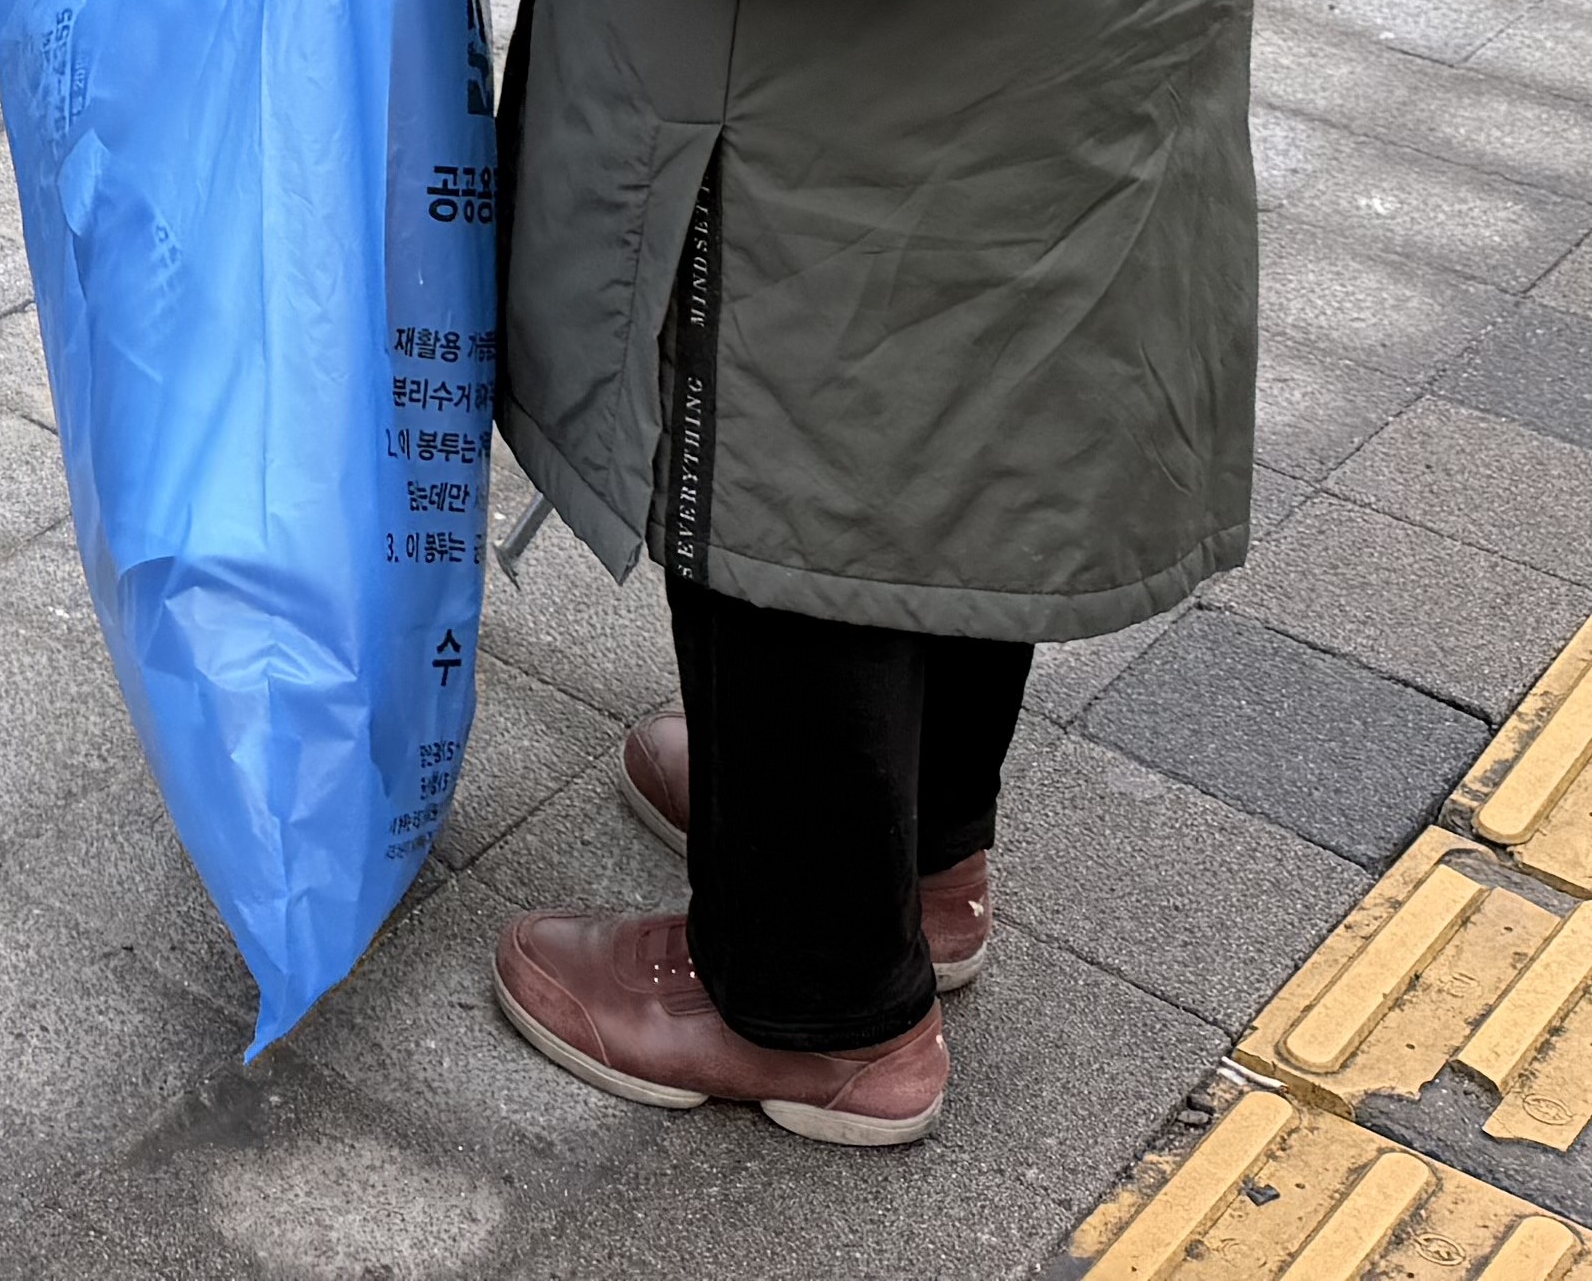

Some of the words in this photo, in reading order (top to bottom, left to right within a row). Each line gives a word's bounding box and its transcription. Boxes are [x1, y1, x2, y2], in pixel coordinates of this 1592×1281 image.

[394, 326, 462, 364] 재활용
[392, 374, 472, 414] 분리수거
[676, 376, 705, 559] EVERYTHING
[387, 532, 400, 564] 3.
